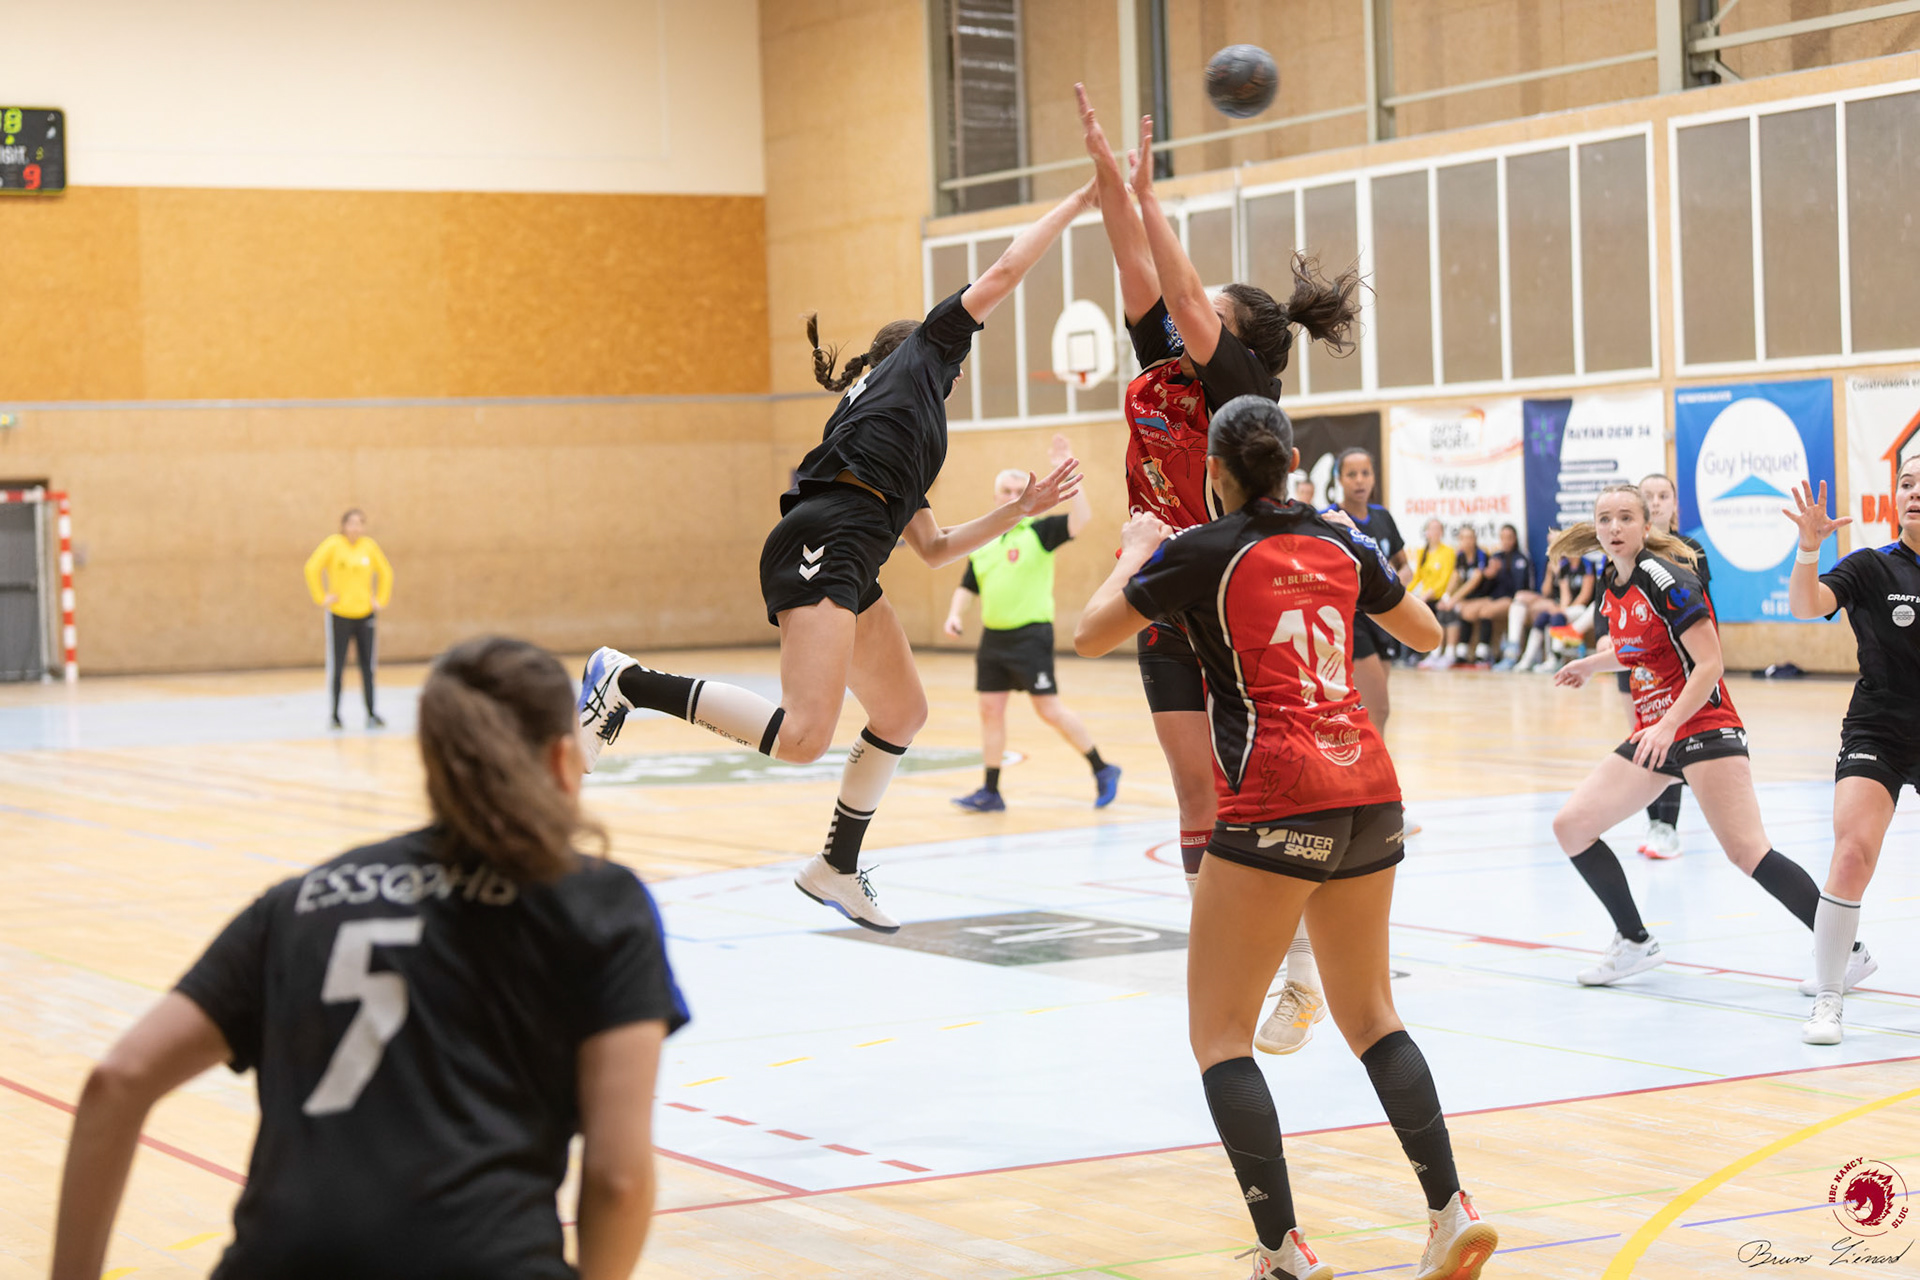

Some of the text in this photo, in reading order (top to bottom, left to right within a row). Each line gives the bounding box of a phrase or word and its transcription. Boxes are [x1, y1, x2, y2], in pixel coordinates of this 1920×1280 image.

[23, 163, 42, 190] 9
[1703, 451, 1799, 478] Guy Hoquet
[1436, 475, 1477, 491] Votre
[1272, 576, 1286, 587] AU
[1887, 593, 1916, 603] CRAFT
[1287, 830, 1334, 850] INTER
[1283, 843, 1331, 862] SPORT
[302, 916, 425, 1117] 5
